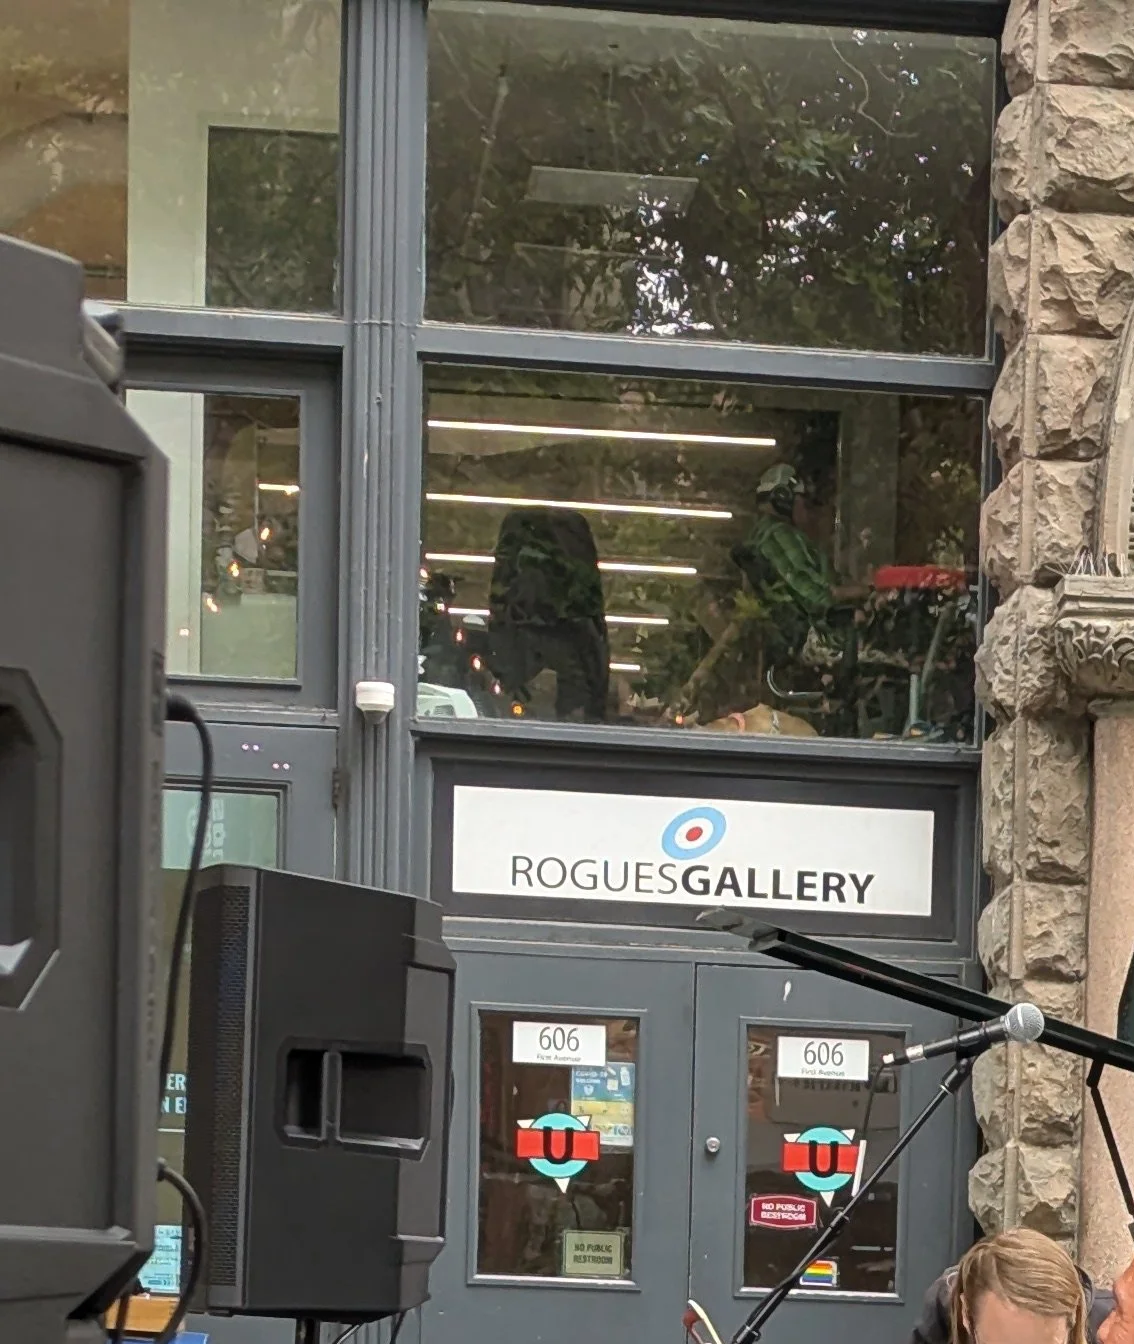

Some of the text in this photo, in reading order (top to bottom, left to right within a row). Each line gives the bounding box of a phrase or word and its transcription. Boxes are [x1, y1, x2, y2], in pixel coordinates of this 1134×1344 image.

[511, 854, 876, 905] ROGUESGALLERY
[539, 1026, 580, 1052] 606
[804, 1041, 844, 1067] 606
[542, 1125, 574, 1165] U
[809, 1139, 840, 1179] U
[761, 1202, 806, 1212] NO PUBLIC
[573, 1255, 613, 1265] RESTROOM
[574, 1243, 613, 1254] NO PUBLIC
